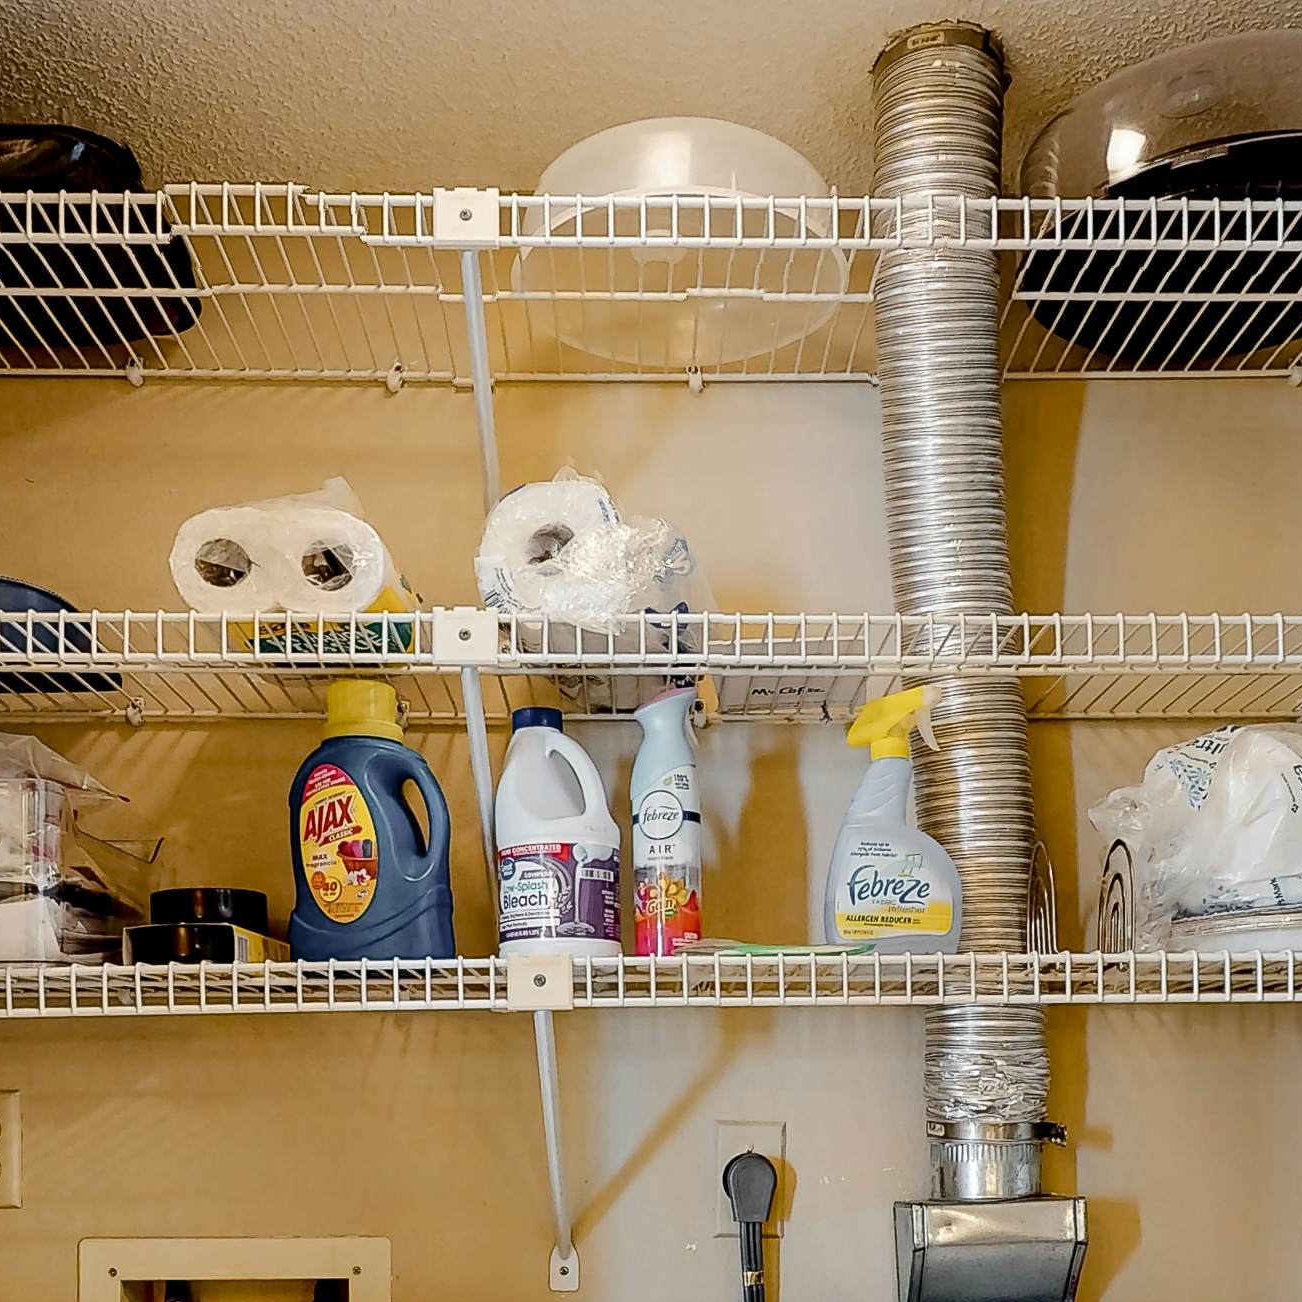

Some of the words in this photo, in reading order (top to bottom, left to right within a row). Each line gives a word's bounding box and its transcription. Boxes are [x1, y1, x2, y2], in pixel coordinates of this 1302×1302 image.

[303, 794, 356, 843] AJAX
[642, 806, 680, 824] febreze
[328, 828, 355, 842] CLASSIC
[648, 844, 672, 855] AIR
[503, 891, 549, 910] Bleach
[845, 914, 880, 923] ALLERGEN
[880, 915, 912, 924] REDUCER
